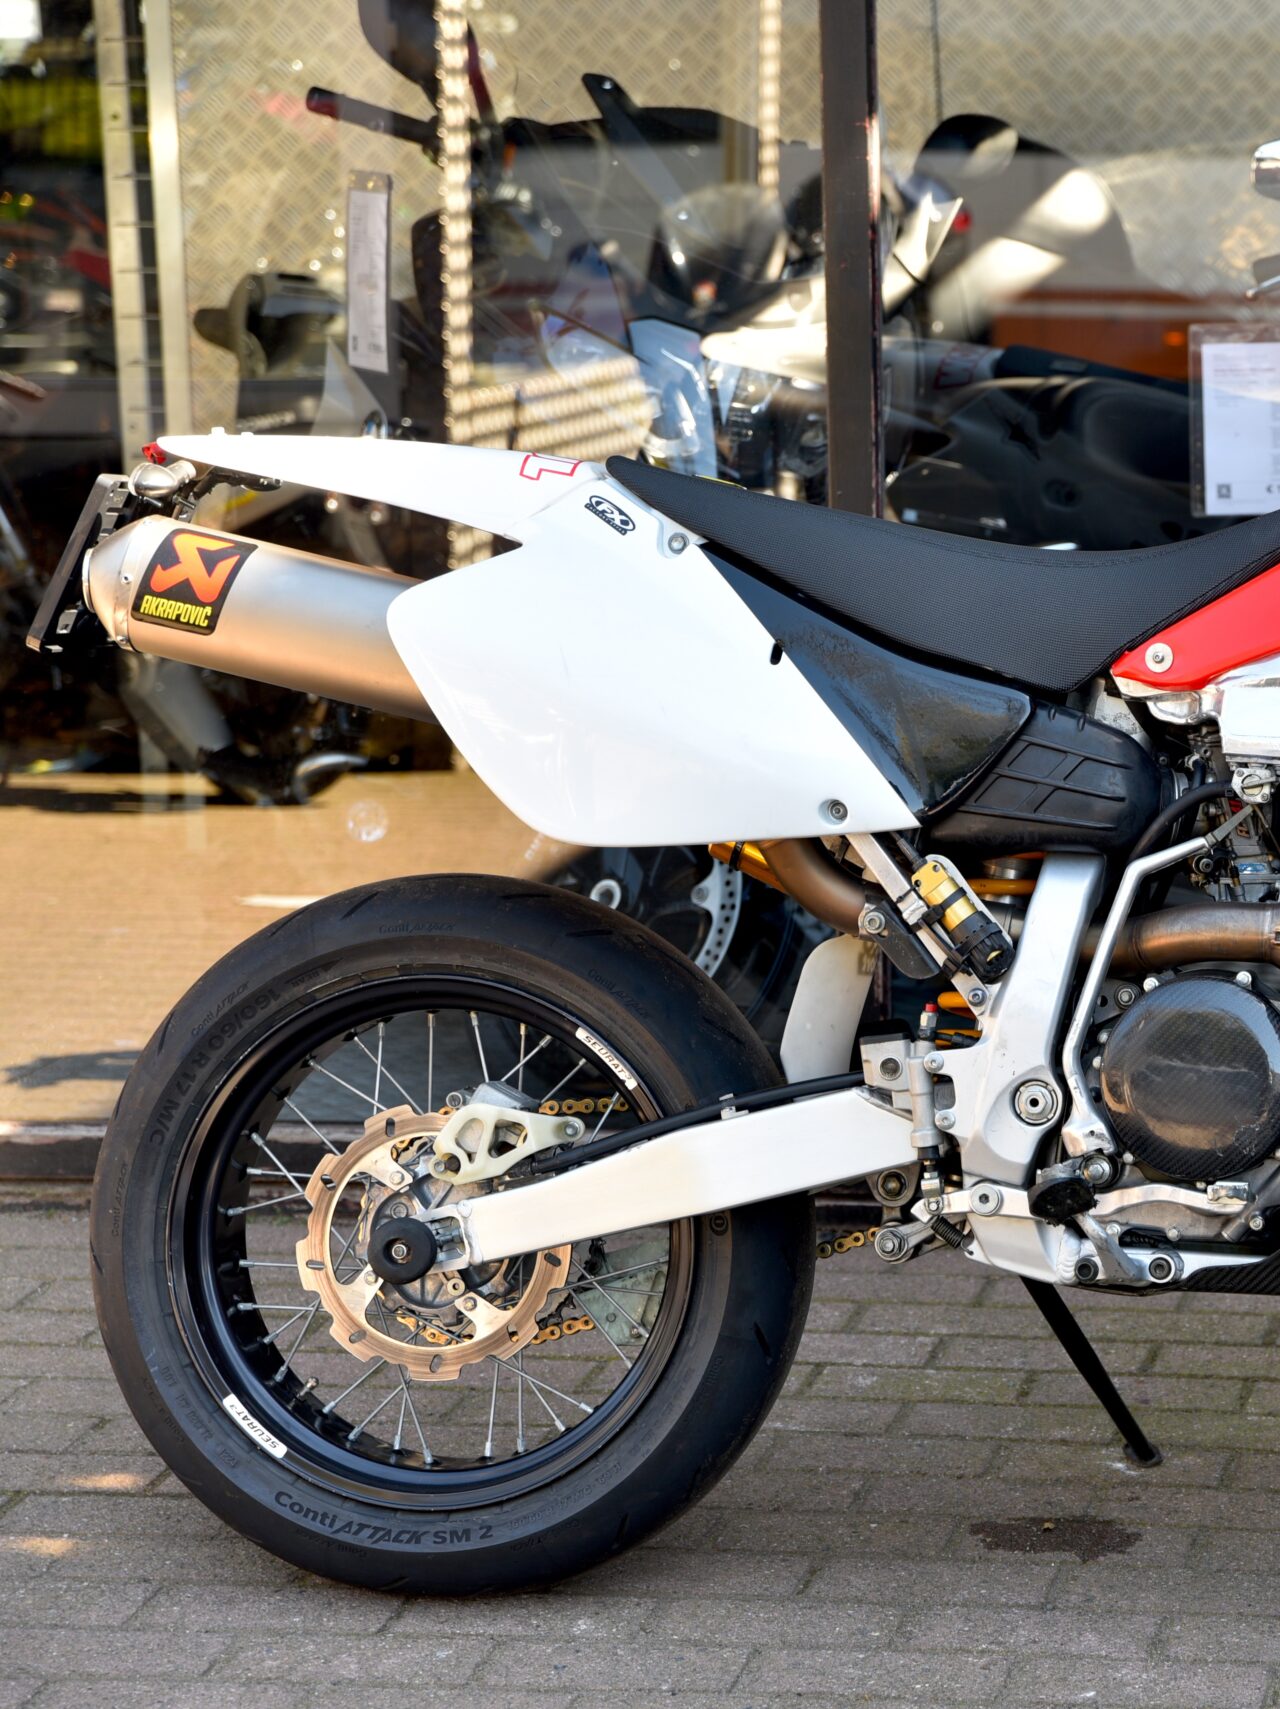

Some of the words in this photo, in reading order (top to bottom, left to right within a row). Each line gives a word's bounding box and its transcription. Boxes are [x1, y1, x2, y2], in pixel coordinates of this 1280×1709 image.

[140, 595, 212, 627] AKRAPOVIČ
[207, 986, 281, 1052] 160/60
[191, 1050, 211, 1070] R
[174, 1069, 197, 1095] 17
[148, 1099, 179, 1147] M/C
[432, 1526, 473, 1545] SM
[478, 1524, 494, 1540] 2
